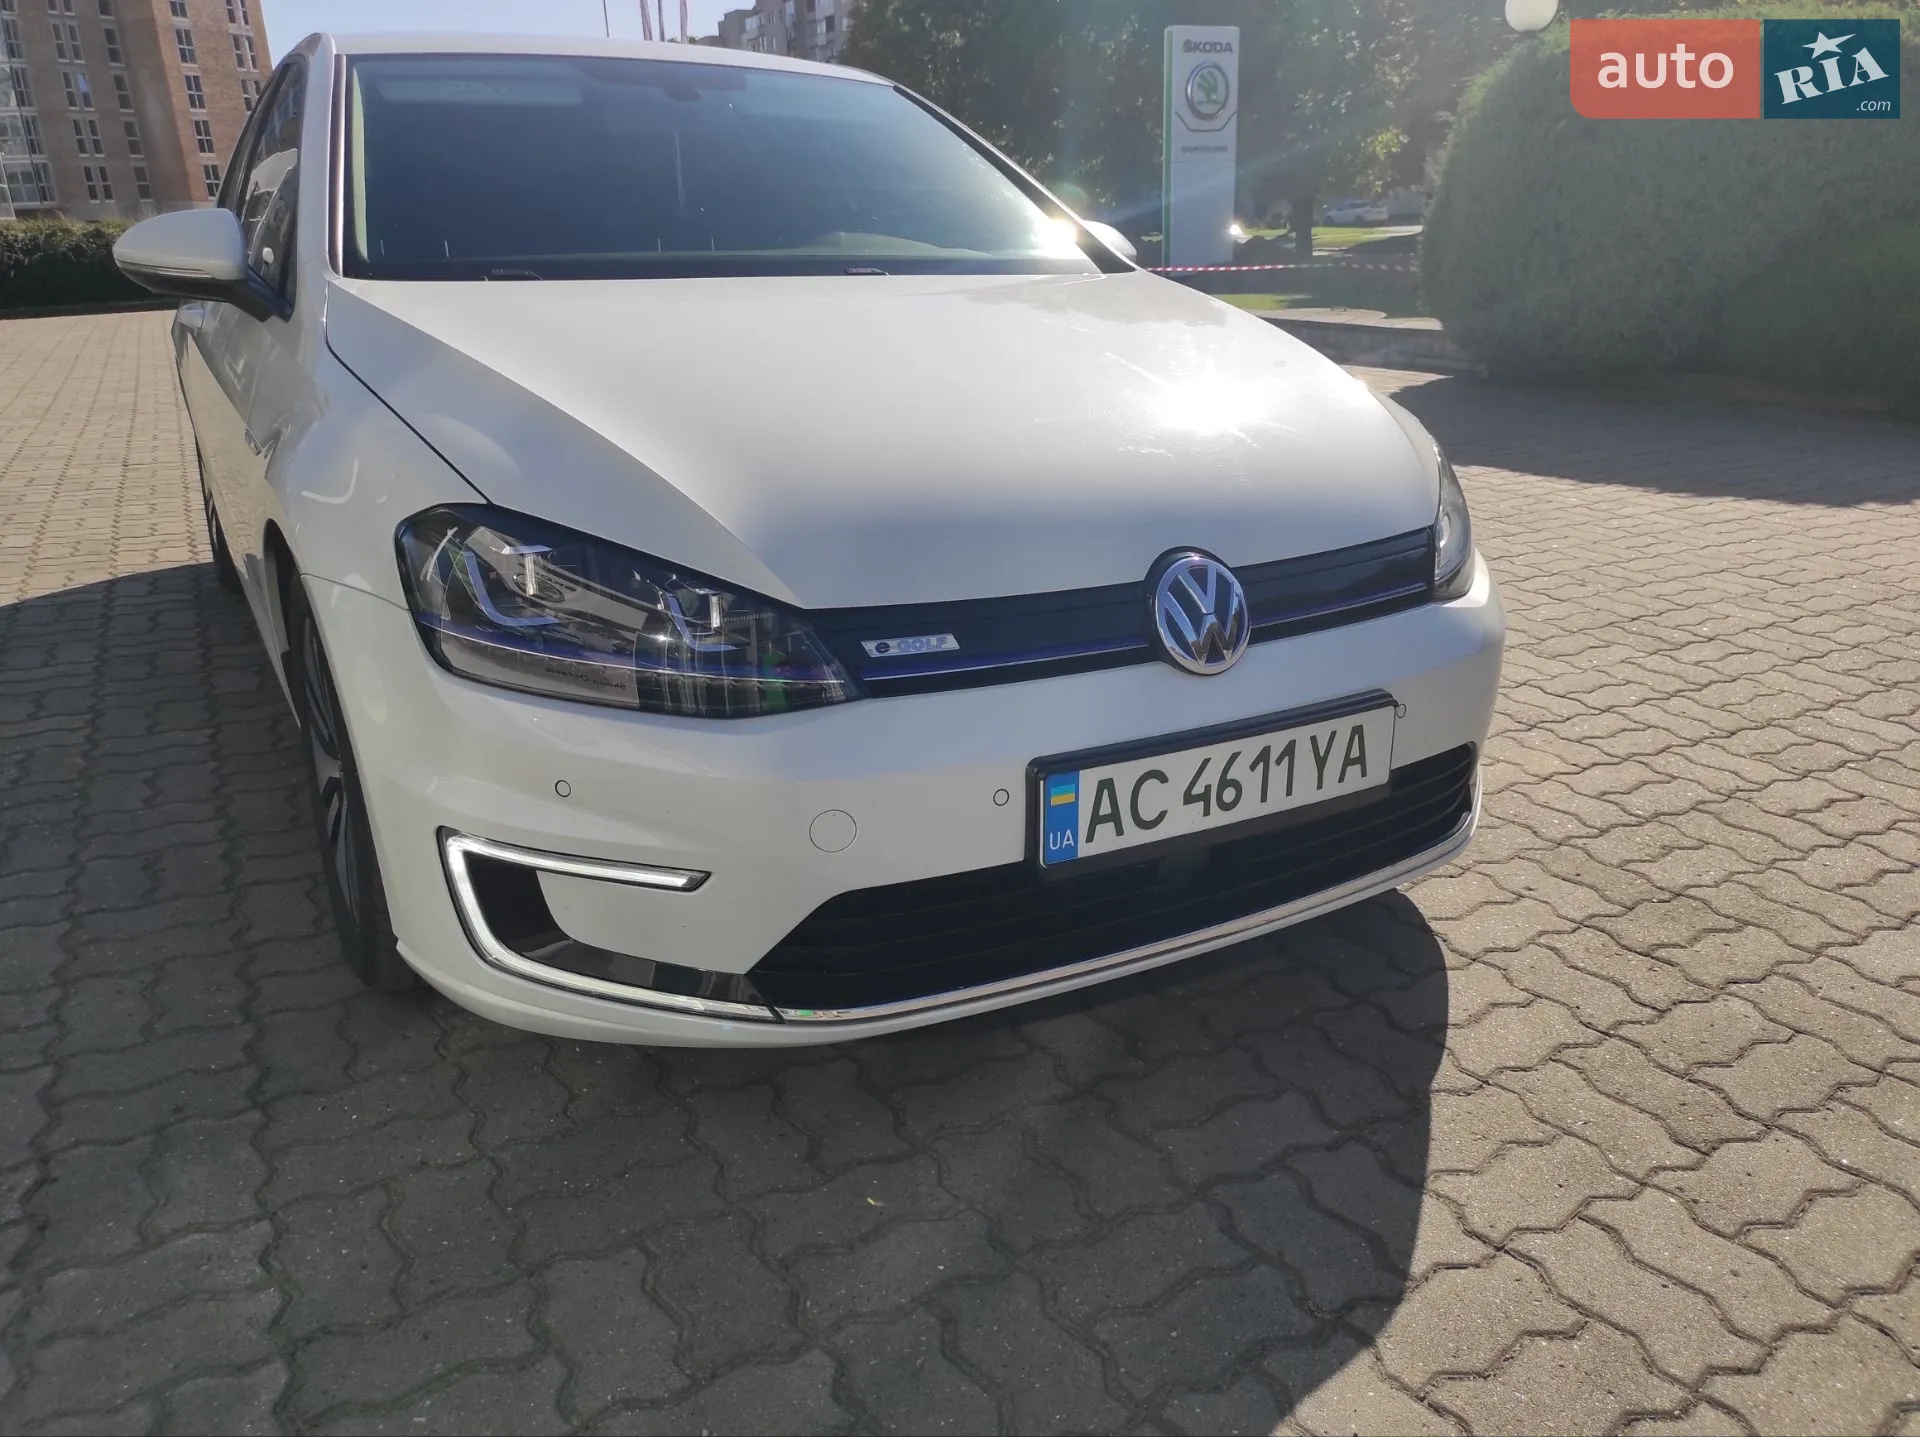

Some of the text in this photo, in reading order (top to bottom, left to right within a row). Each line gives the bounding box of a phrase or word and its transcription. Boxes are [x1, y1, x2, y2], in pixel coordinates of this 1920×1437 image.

[1183, 38, 1233, 53] ŠKODA
[1085, 724, 1368, 843] AC 4611 YA
[1050, 829, 1075, 850] UA
